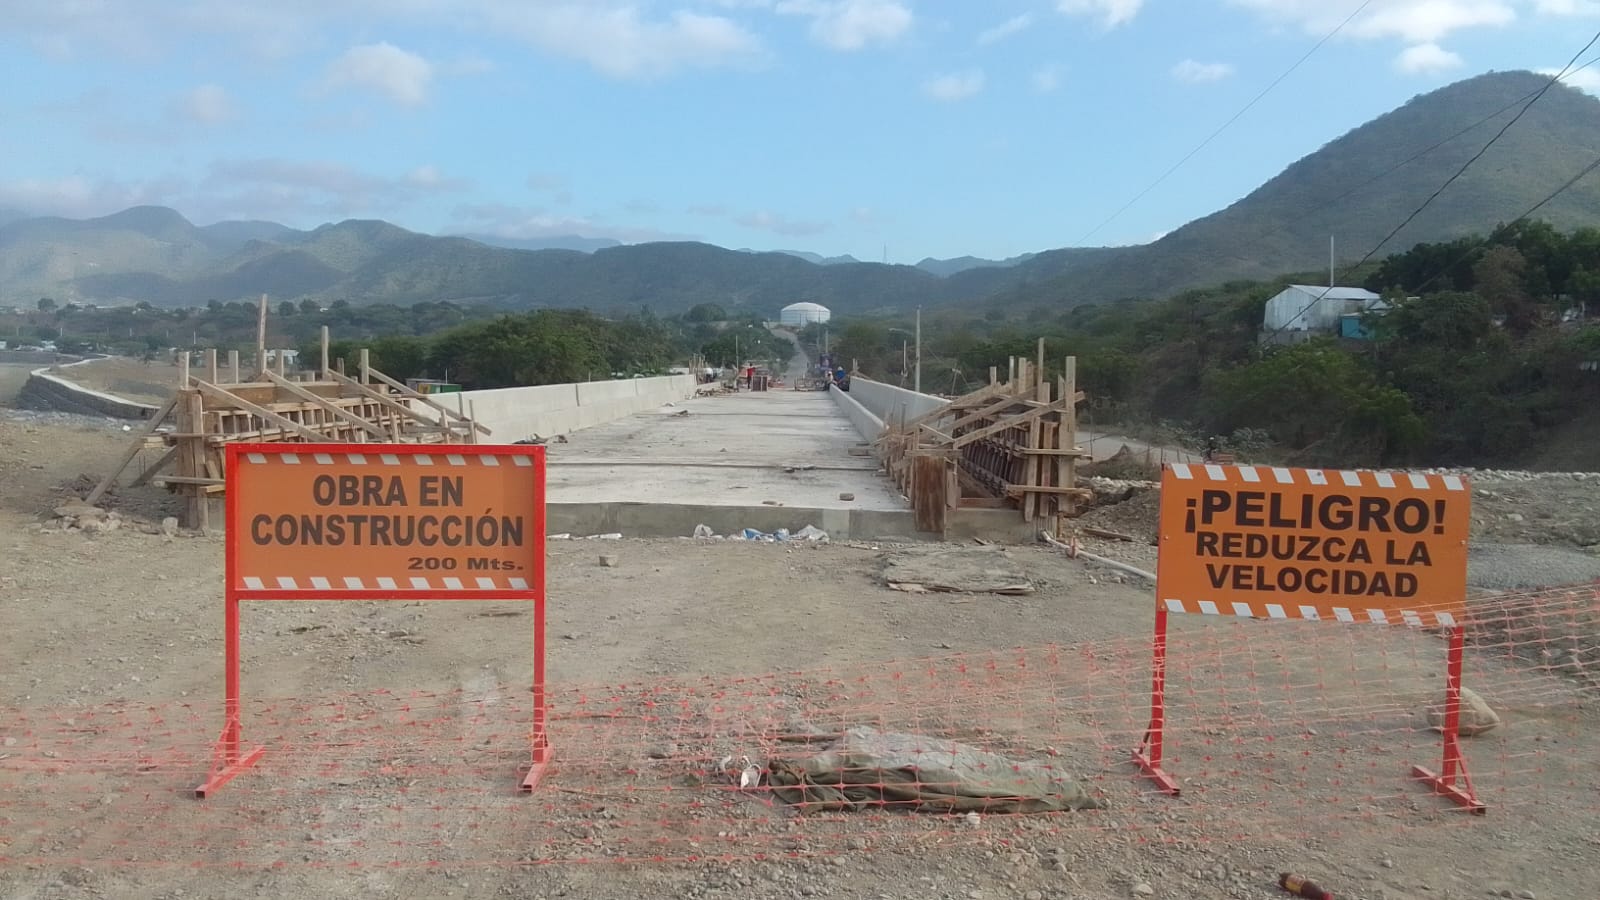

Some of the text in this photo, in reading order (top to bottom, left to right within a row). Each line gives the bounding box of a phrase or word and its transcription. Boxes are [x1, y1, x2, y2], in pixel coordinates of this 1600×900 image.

[313, 474, 464, 507] OBRA EN
[251, 508, 523, 547] CONSTRUCCIÓN
[1185, 489, 1446, 535] ¡PELIGRO!
[407, 557, 523, 570] 200 Mts.
[1195, 531, 1433, 567] REDUZCA LA
[1205, 563, 1419, 598] VELOCIDAD
